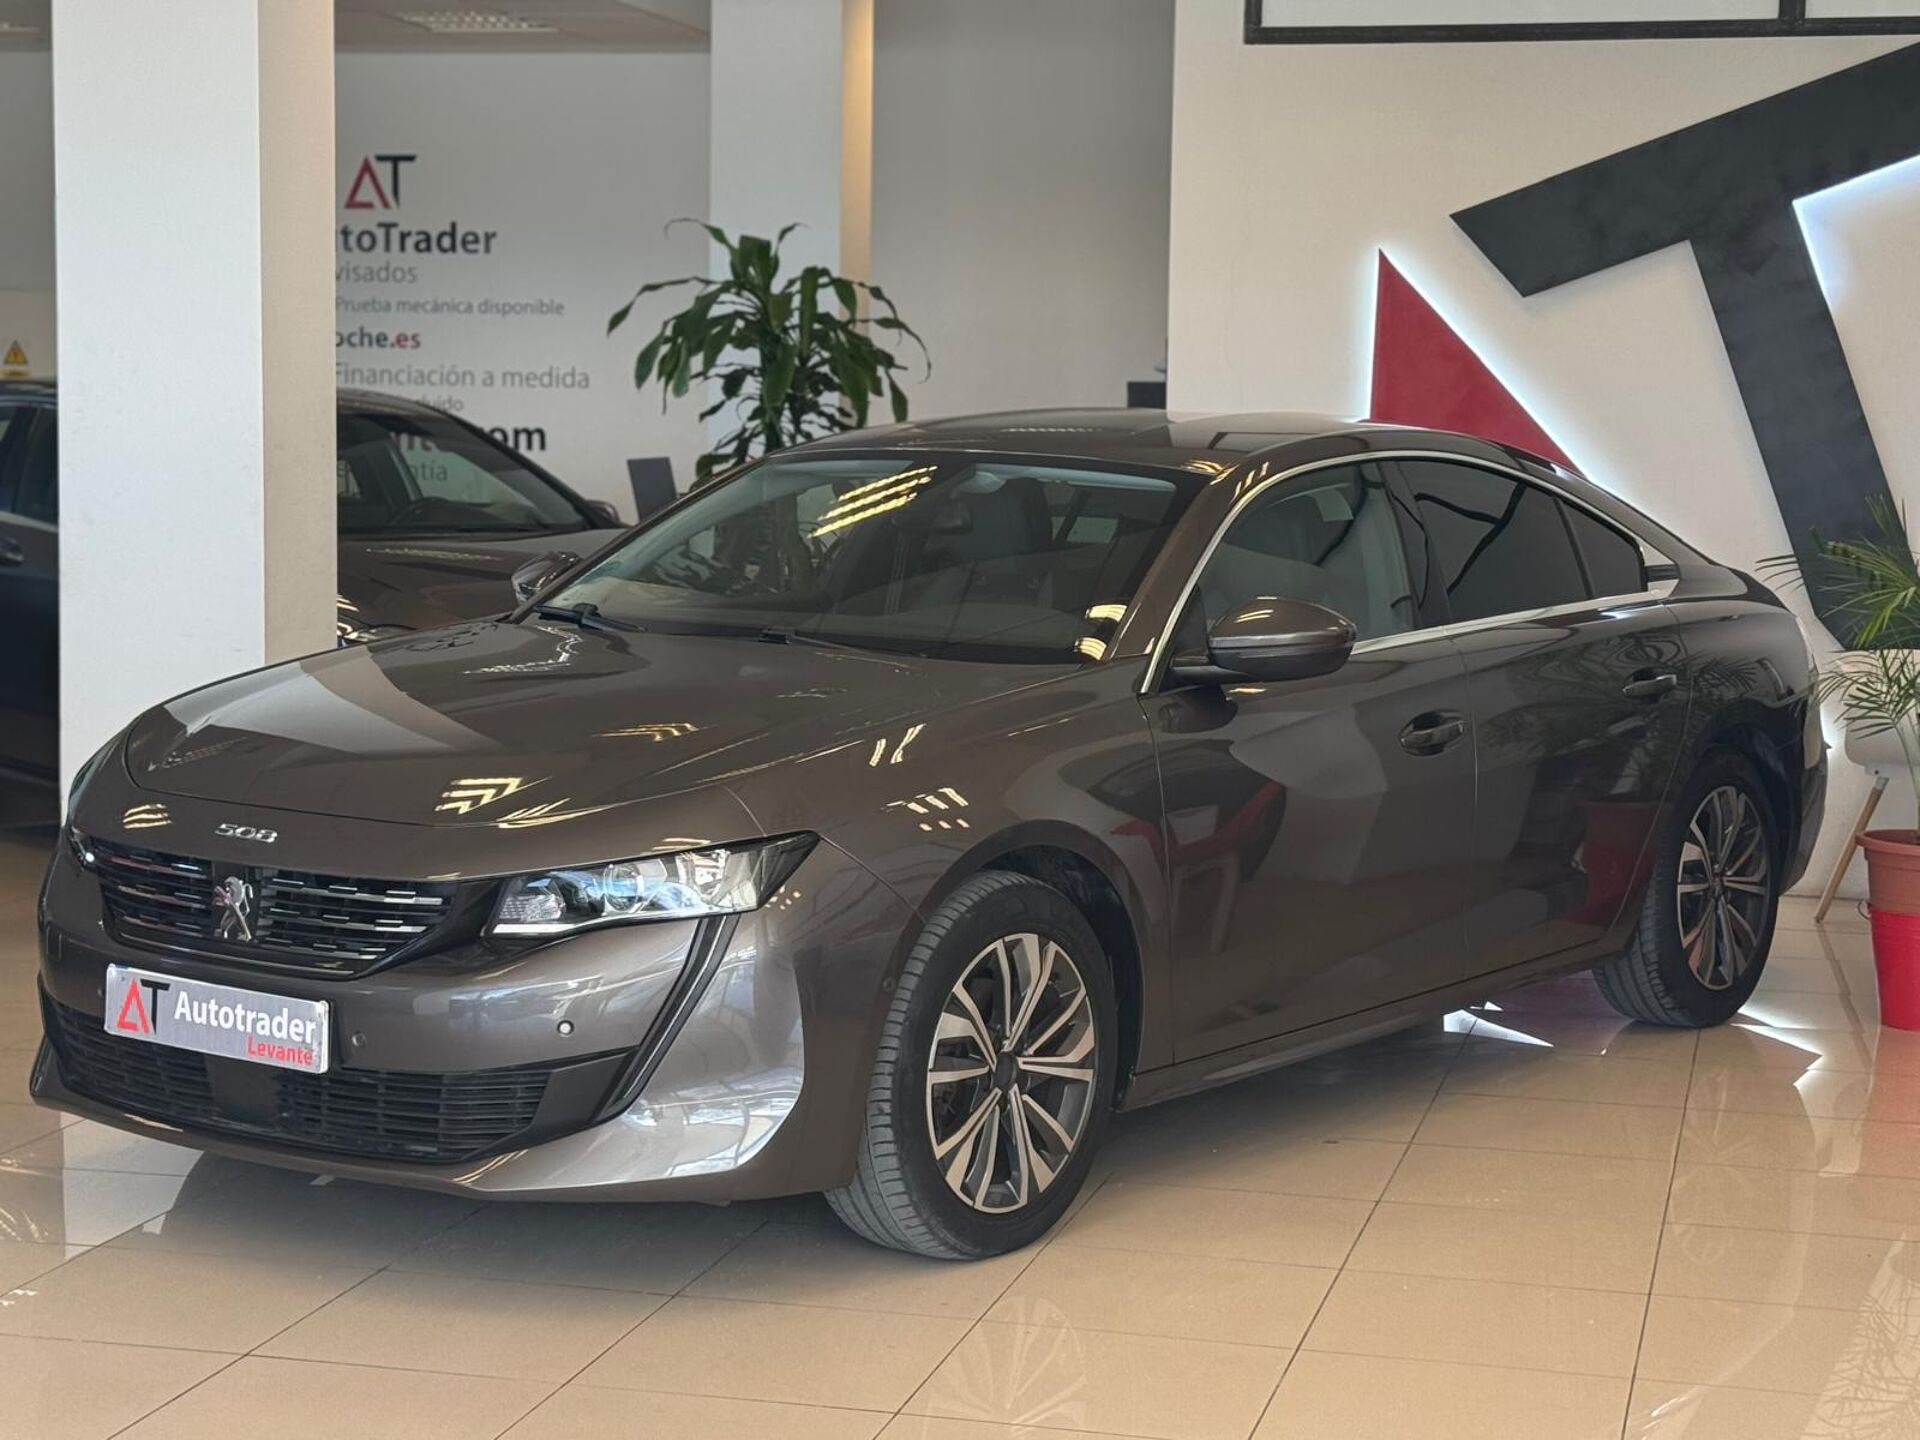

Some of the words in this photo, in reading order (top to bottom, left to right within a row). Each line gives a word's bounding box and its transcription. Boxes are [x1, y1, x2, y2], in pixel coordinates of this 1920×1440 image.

[344, 154, 417, 209] AT
[336, 221, 497, 254] toTrader
[396, 297, 473, 314] mecánica
[477, 299, 565, 317] disponible
[481, 370, 494, 388] a
[501, 365, 590, 389] medida
[215, 823, 278, 843] 508
[116, 977, 171, 1035] AT
[174, 991, 317, 1044] Autotrader
[246, 1034, 314, 1067] Levante
